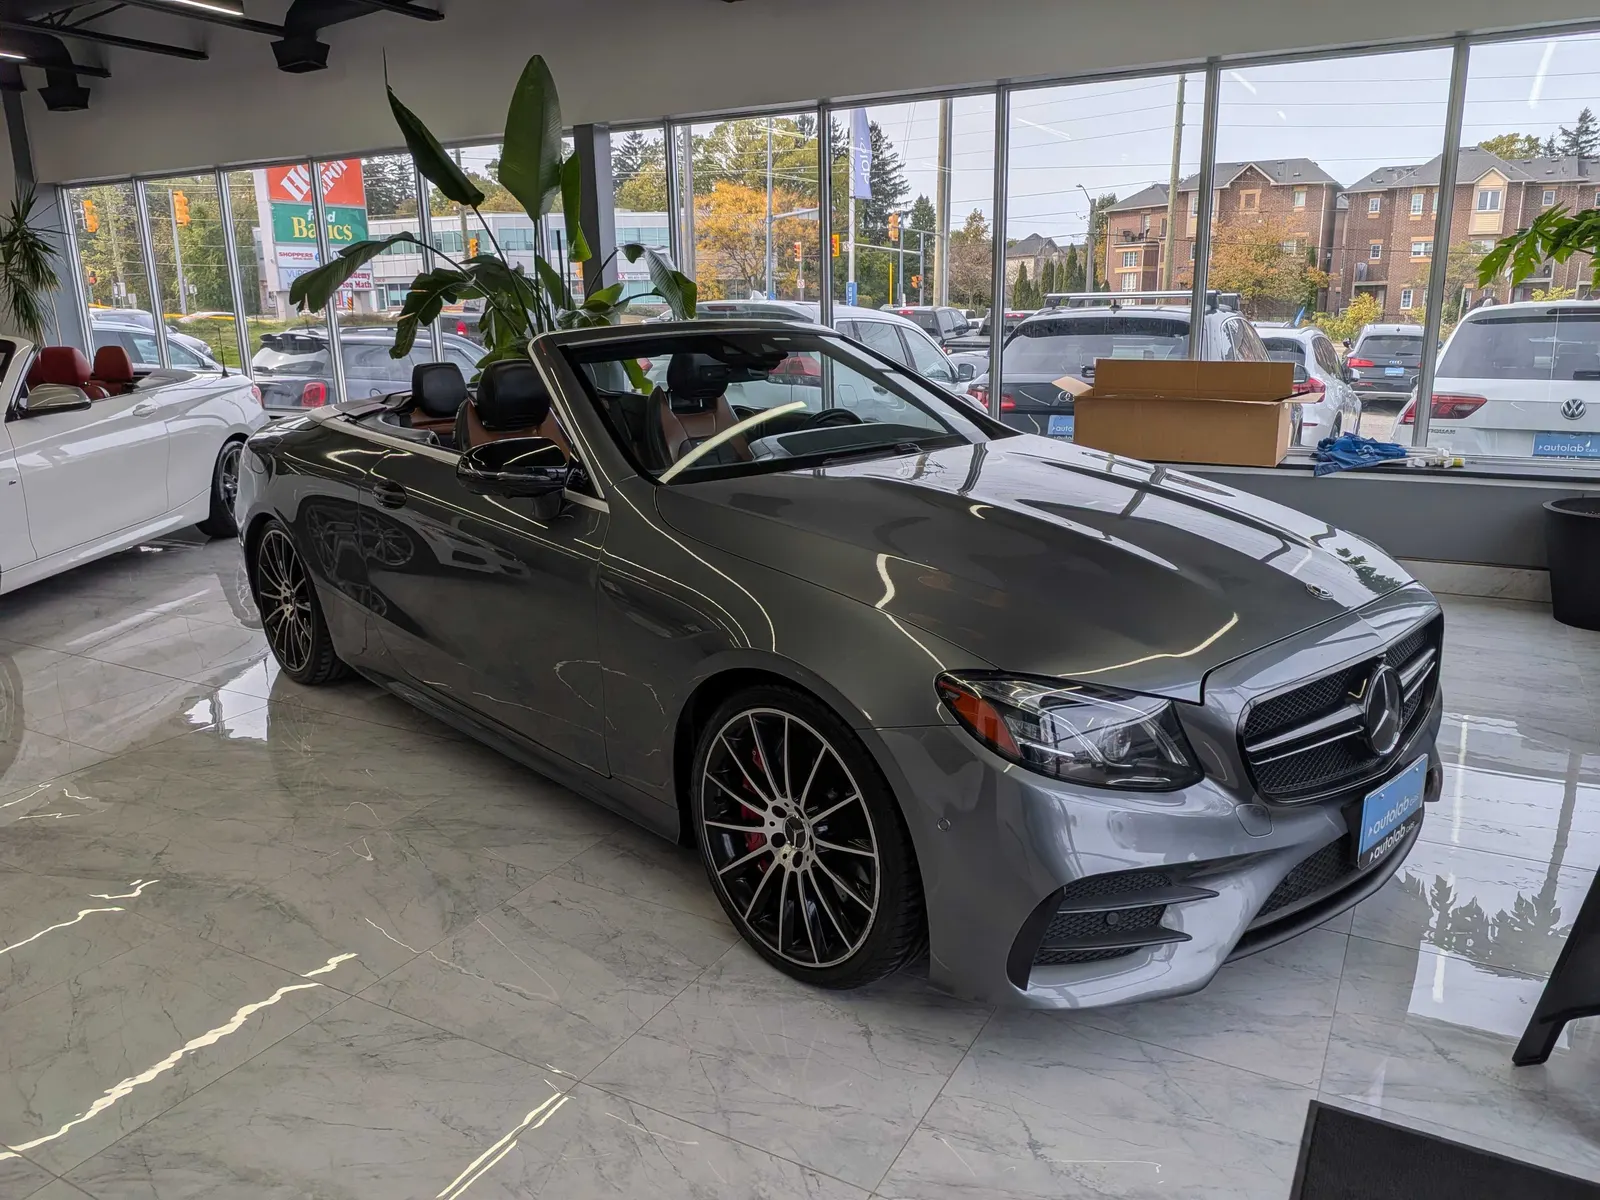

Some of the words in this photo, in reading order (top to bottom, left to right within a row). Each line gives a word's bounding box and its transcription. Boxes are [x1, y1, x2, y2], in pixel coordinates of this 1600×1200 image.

[321, 160, 348, 196] EPOT
[307, 209, 336, 222] fd
[291, 216, 353, 241] Baic$
[354, 280, 372, 289] Math
[1543, 443, 1584, 453] autolab
[1373, 795, 1410, 835] autolab
[1374, 824, 1406, 860] autolab
